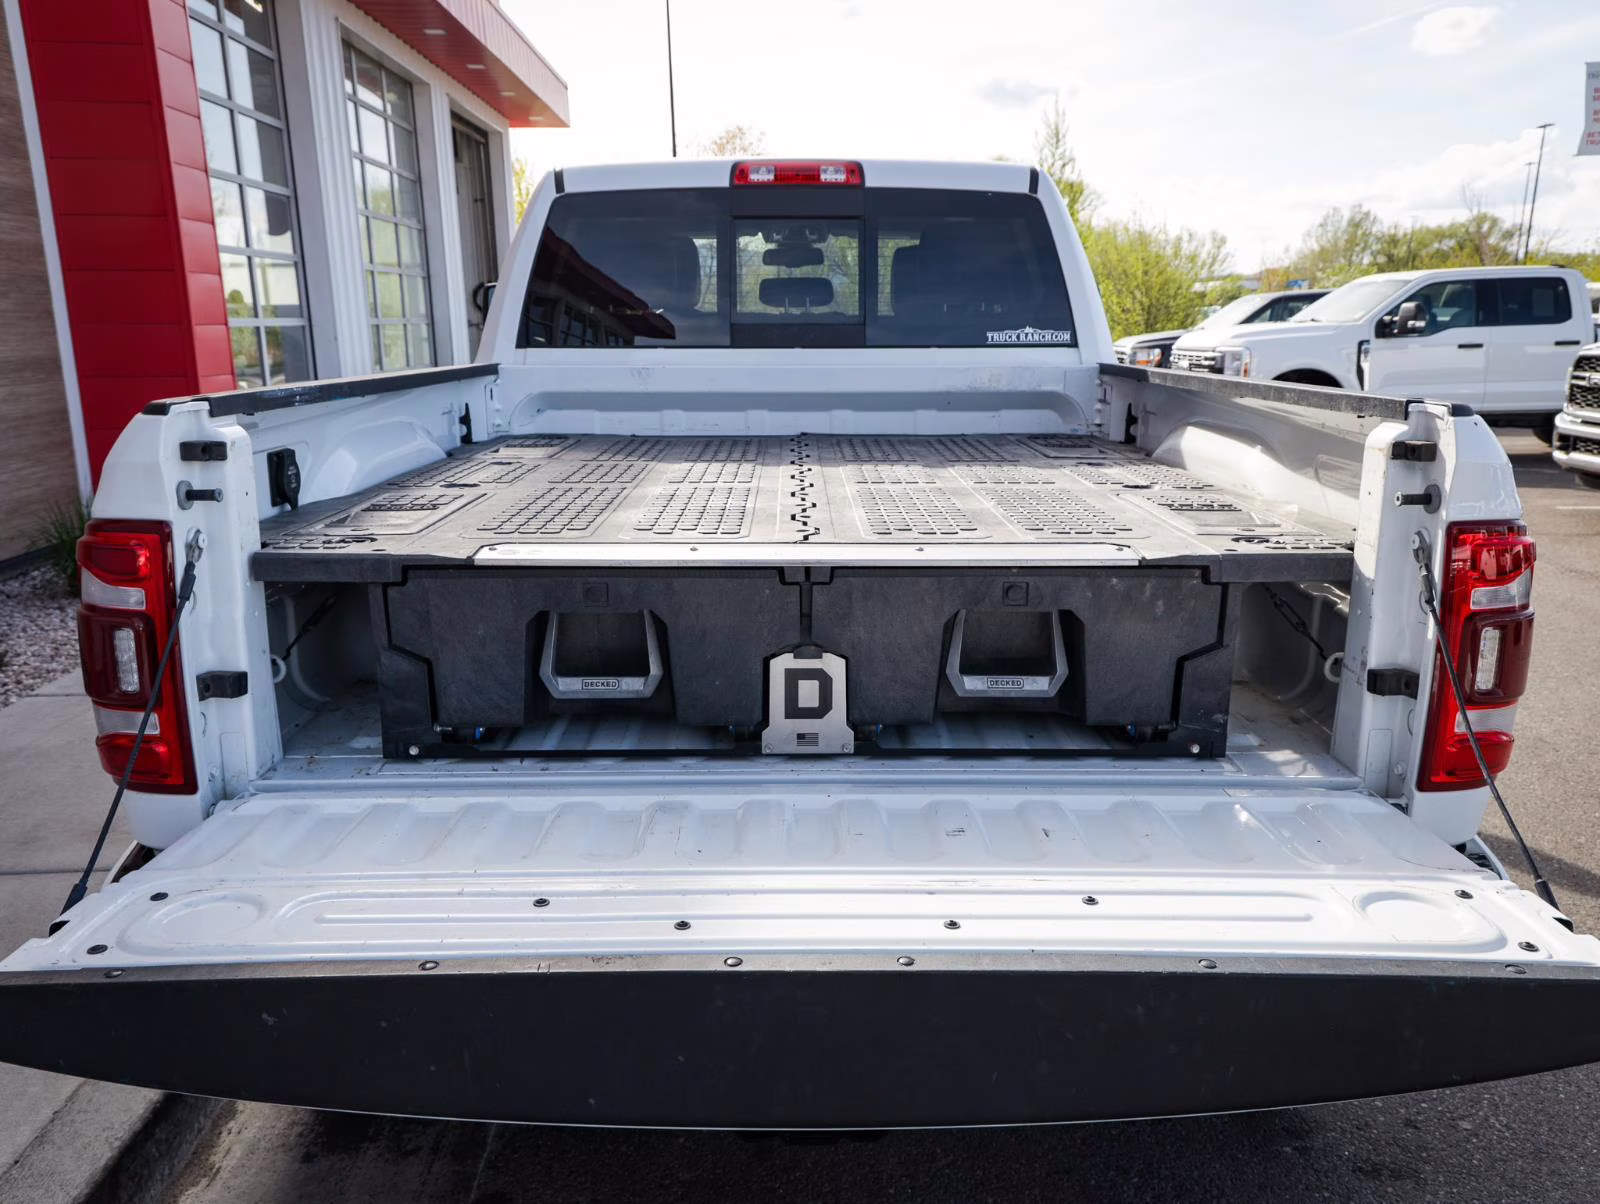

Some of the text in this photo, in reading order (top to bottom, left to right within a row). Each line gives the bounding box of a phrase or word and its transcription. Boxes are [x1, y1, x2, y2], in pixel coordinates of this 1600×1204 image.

[987, 332, 1018, 342] TRUCK
[584, 680, 617, 688] DECKED
[989, 679, 1022, 687] DECKED
[784, 668, 833, 719] D
